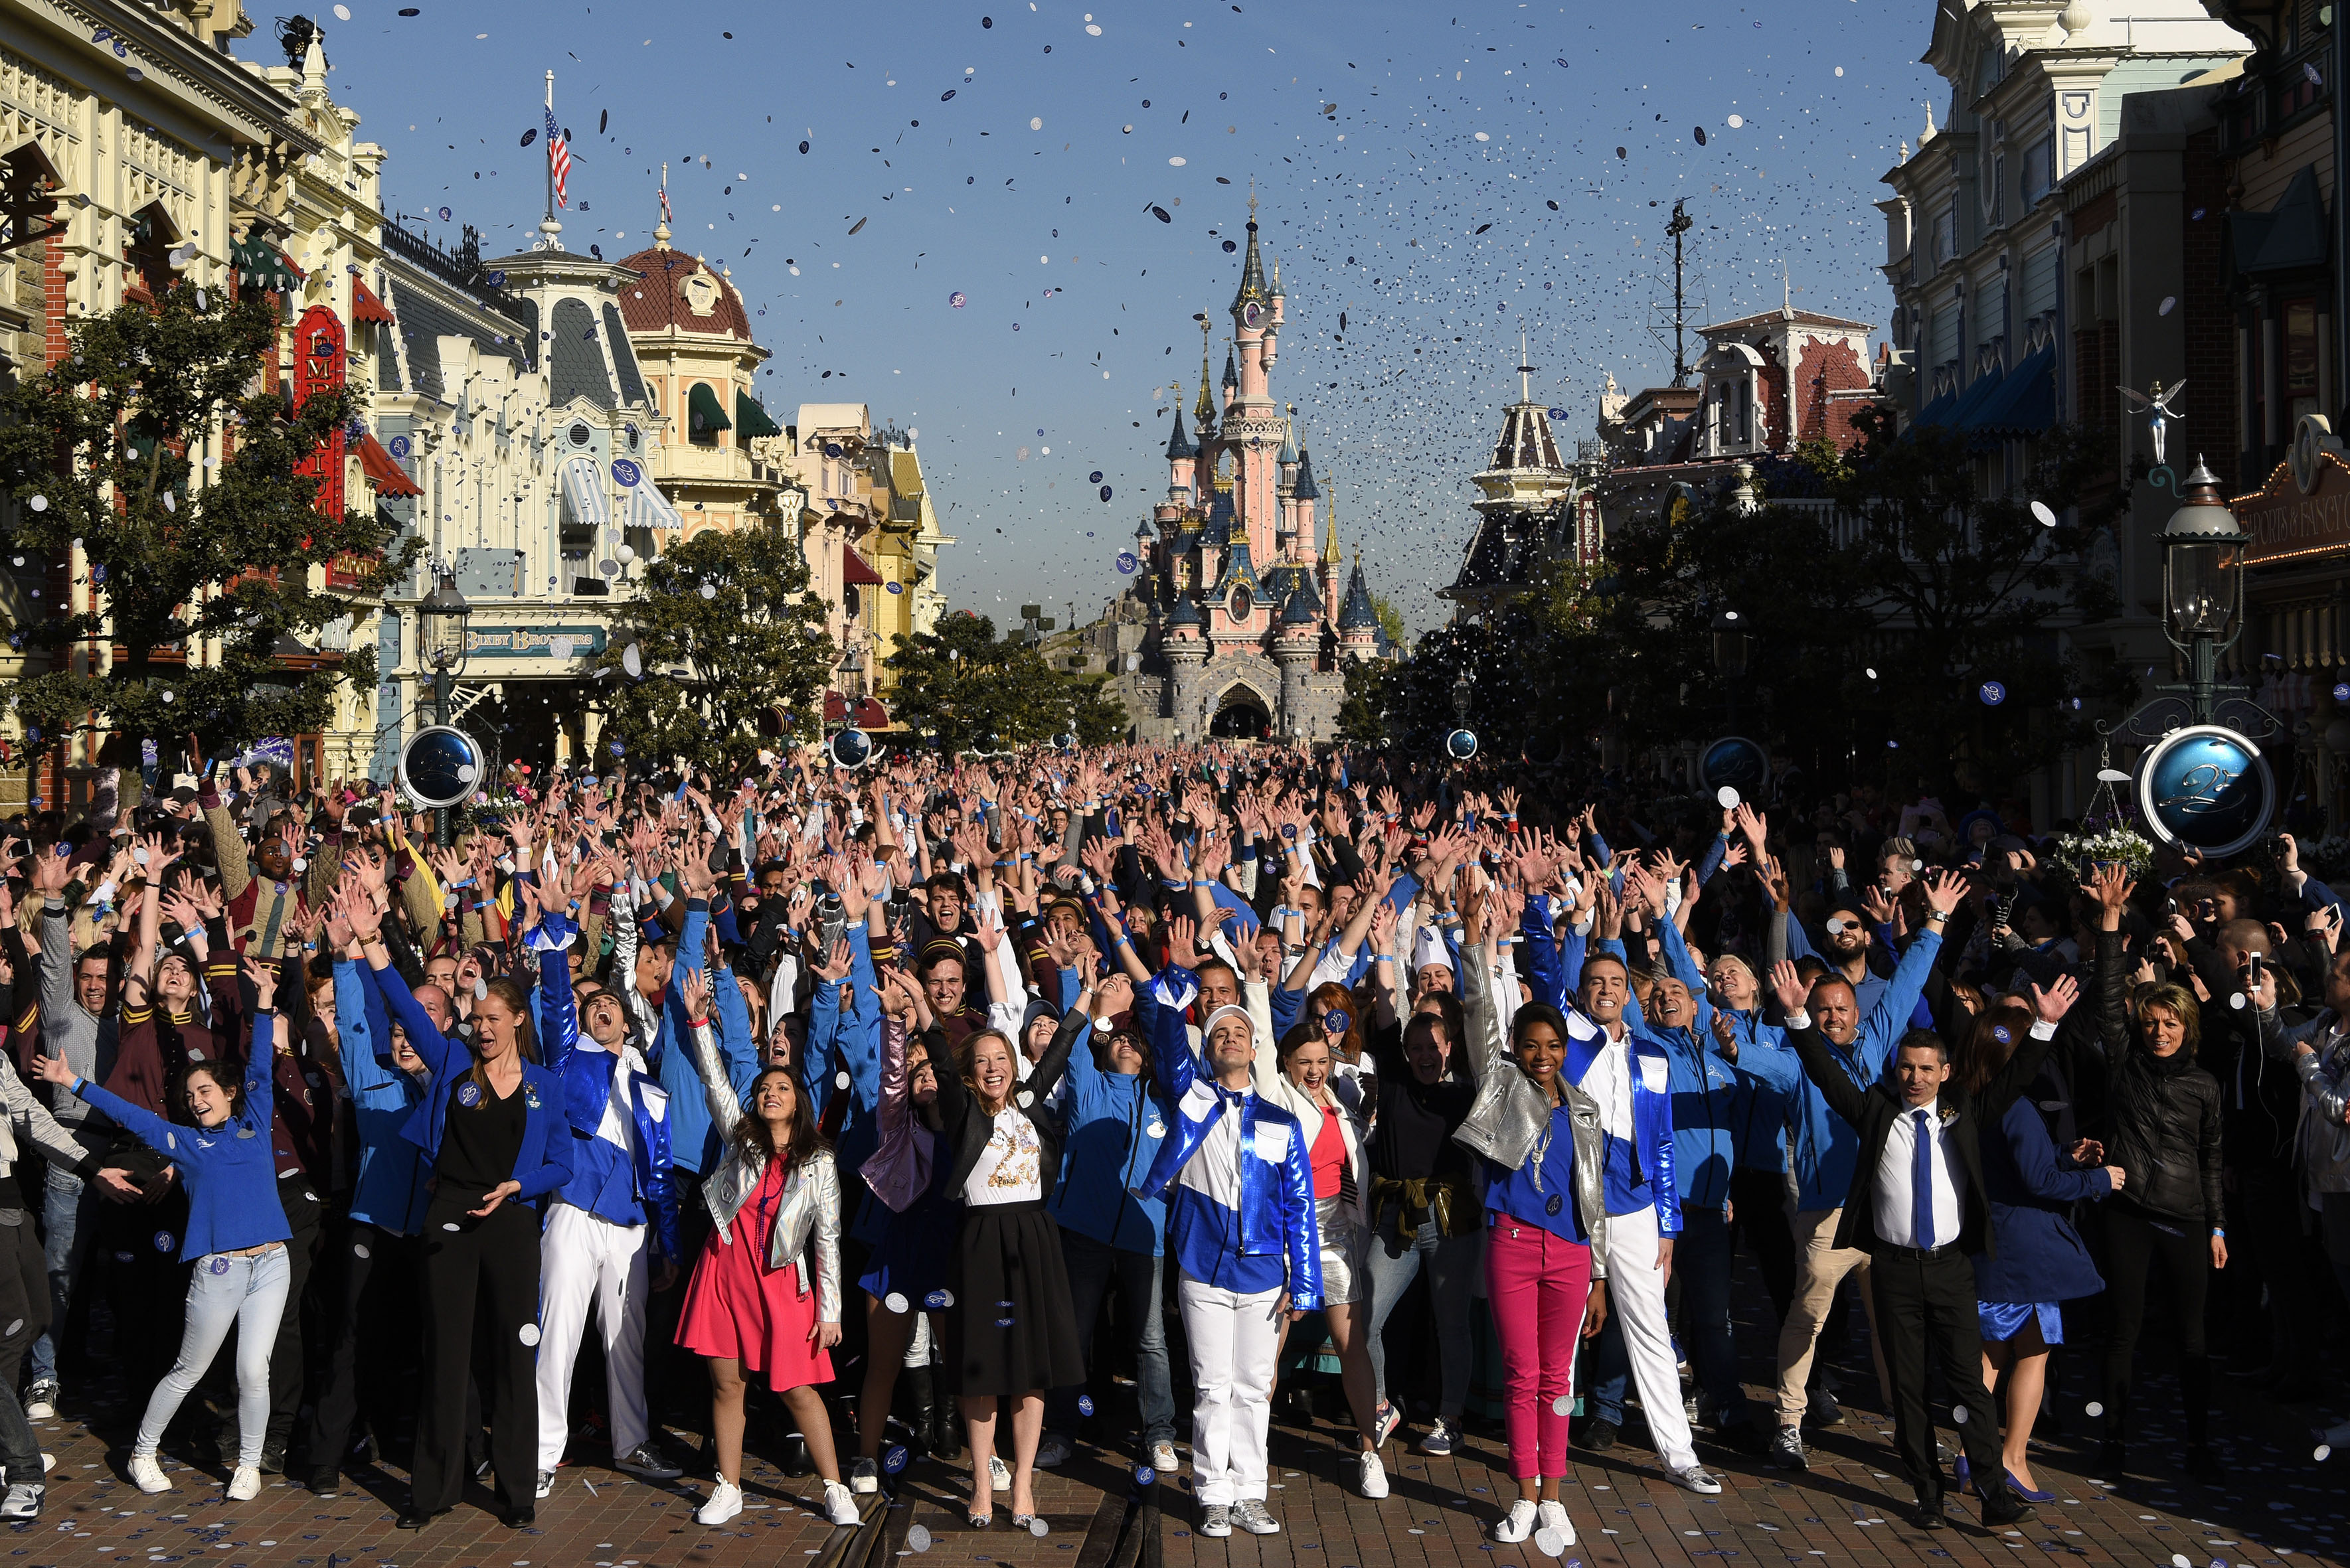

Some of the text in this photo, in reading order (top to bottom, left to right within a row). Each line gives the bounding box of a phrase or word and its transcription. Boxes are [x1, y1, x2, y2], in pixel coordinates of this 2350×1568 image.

[950, 294, 964, 306] 25
[394, 439, 404, 455] 25
[613, 463, 637, 483] 25
[780, 495, 801, 539] WAL
[2290, 505, 2298, 537] &
[2300, 494, 2343, 537] FANCY
[1582, 501, 1594, 554] MARKET
[1118, 557, 1135, 570] 25
[462, 631, 593, 649] BIXBY BROTERS
[1983, 685, 2001, 701] 25
[2333, 686, 2348, 696] 25
[1284, 825, 1294, 838] 25
[1330, 1012, 1344, 1032] 25
[1995, 1029, 2007, 1038] 25
[462, 1084, 477, 1105] 25
[997, 1176, 1017, 1185] PARIS
[1079, 1399, 1092, 1410] 25
[887, 1449, 906, 1467] 25
